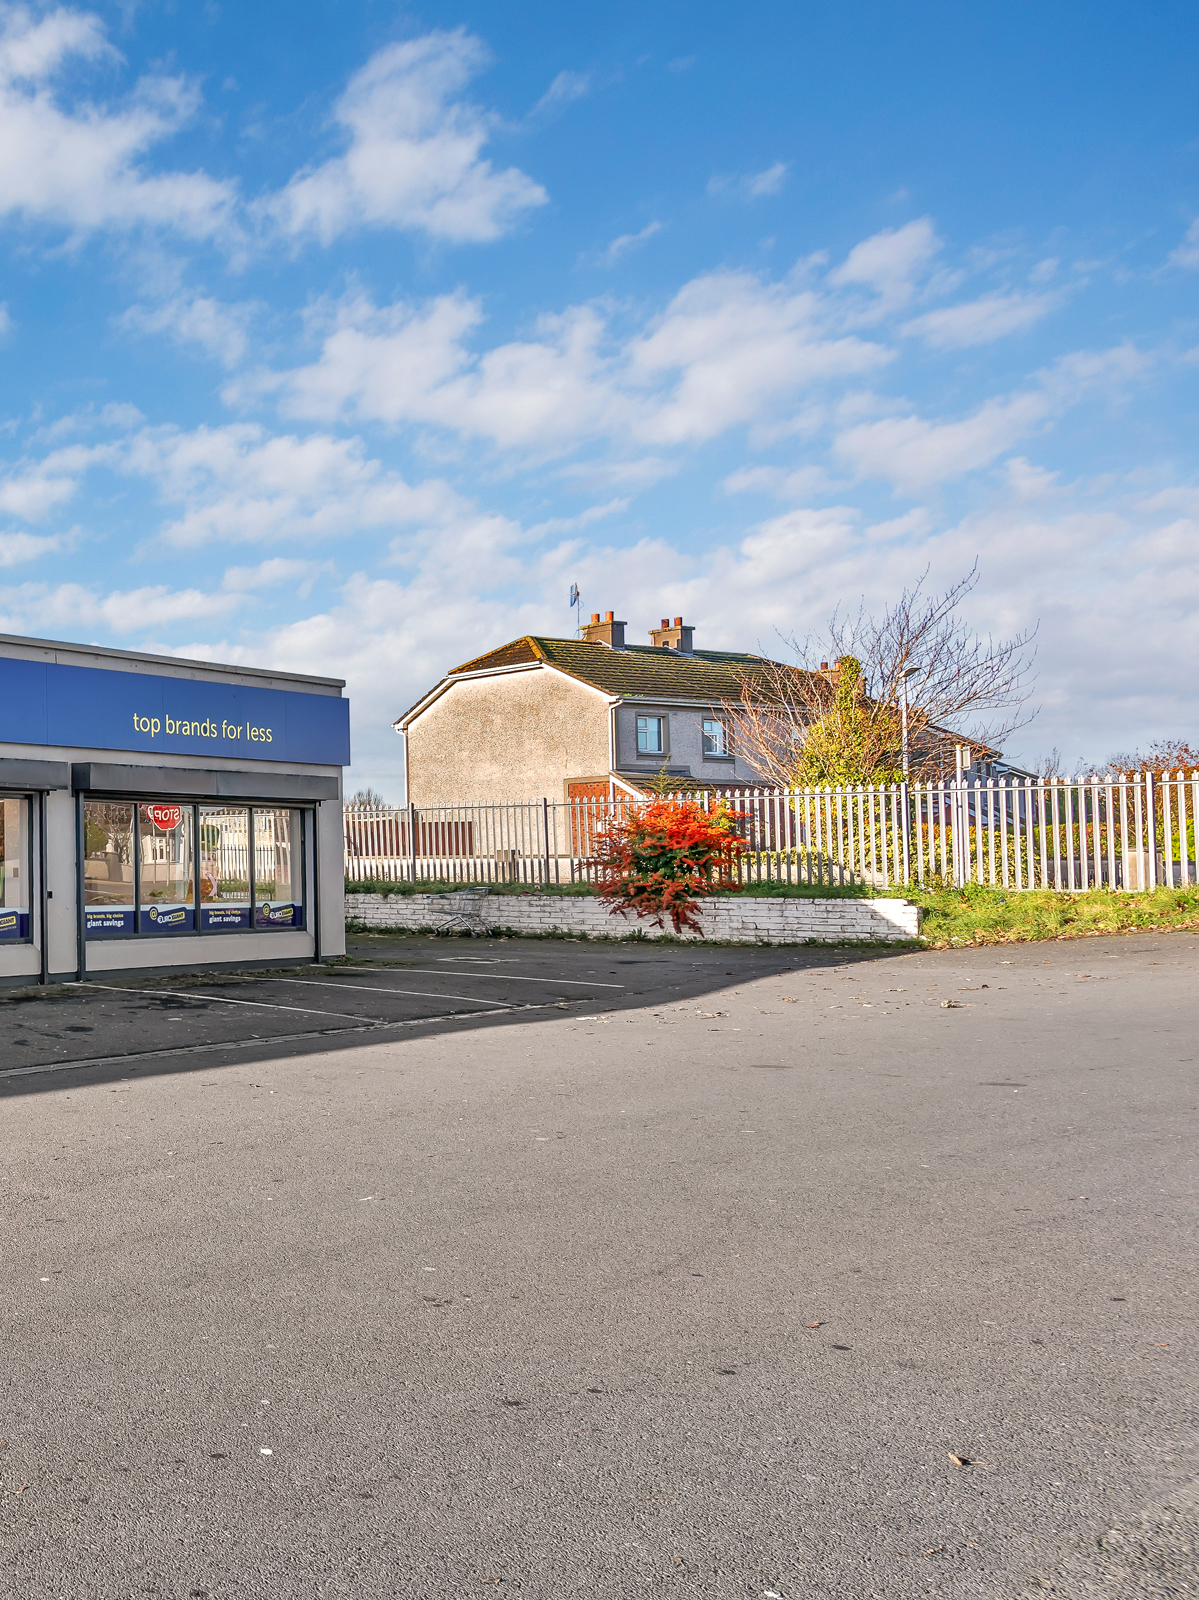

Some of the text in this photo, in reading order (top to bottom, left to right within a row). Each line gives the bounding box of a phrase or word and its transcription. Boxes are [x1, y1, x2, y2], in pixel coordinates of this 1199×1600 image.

[133, 713, 272, 742] top brands for less
[87, 919, 124, 928] giant savings
